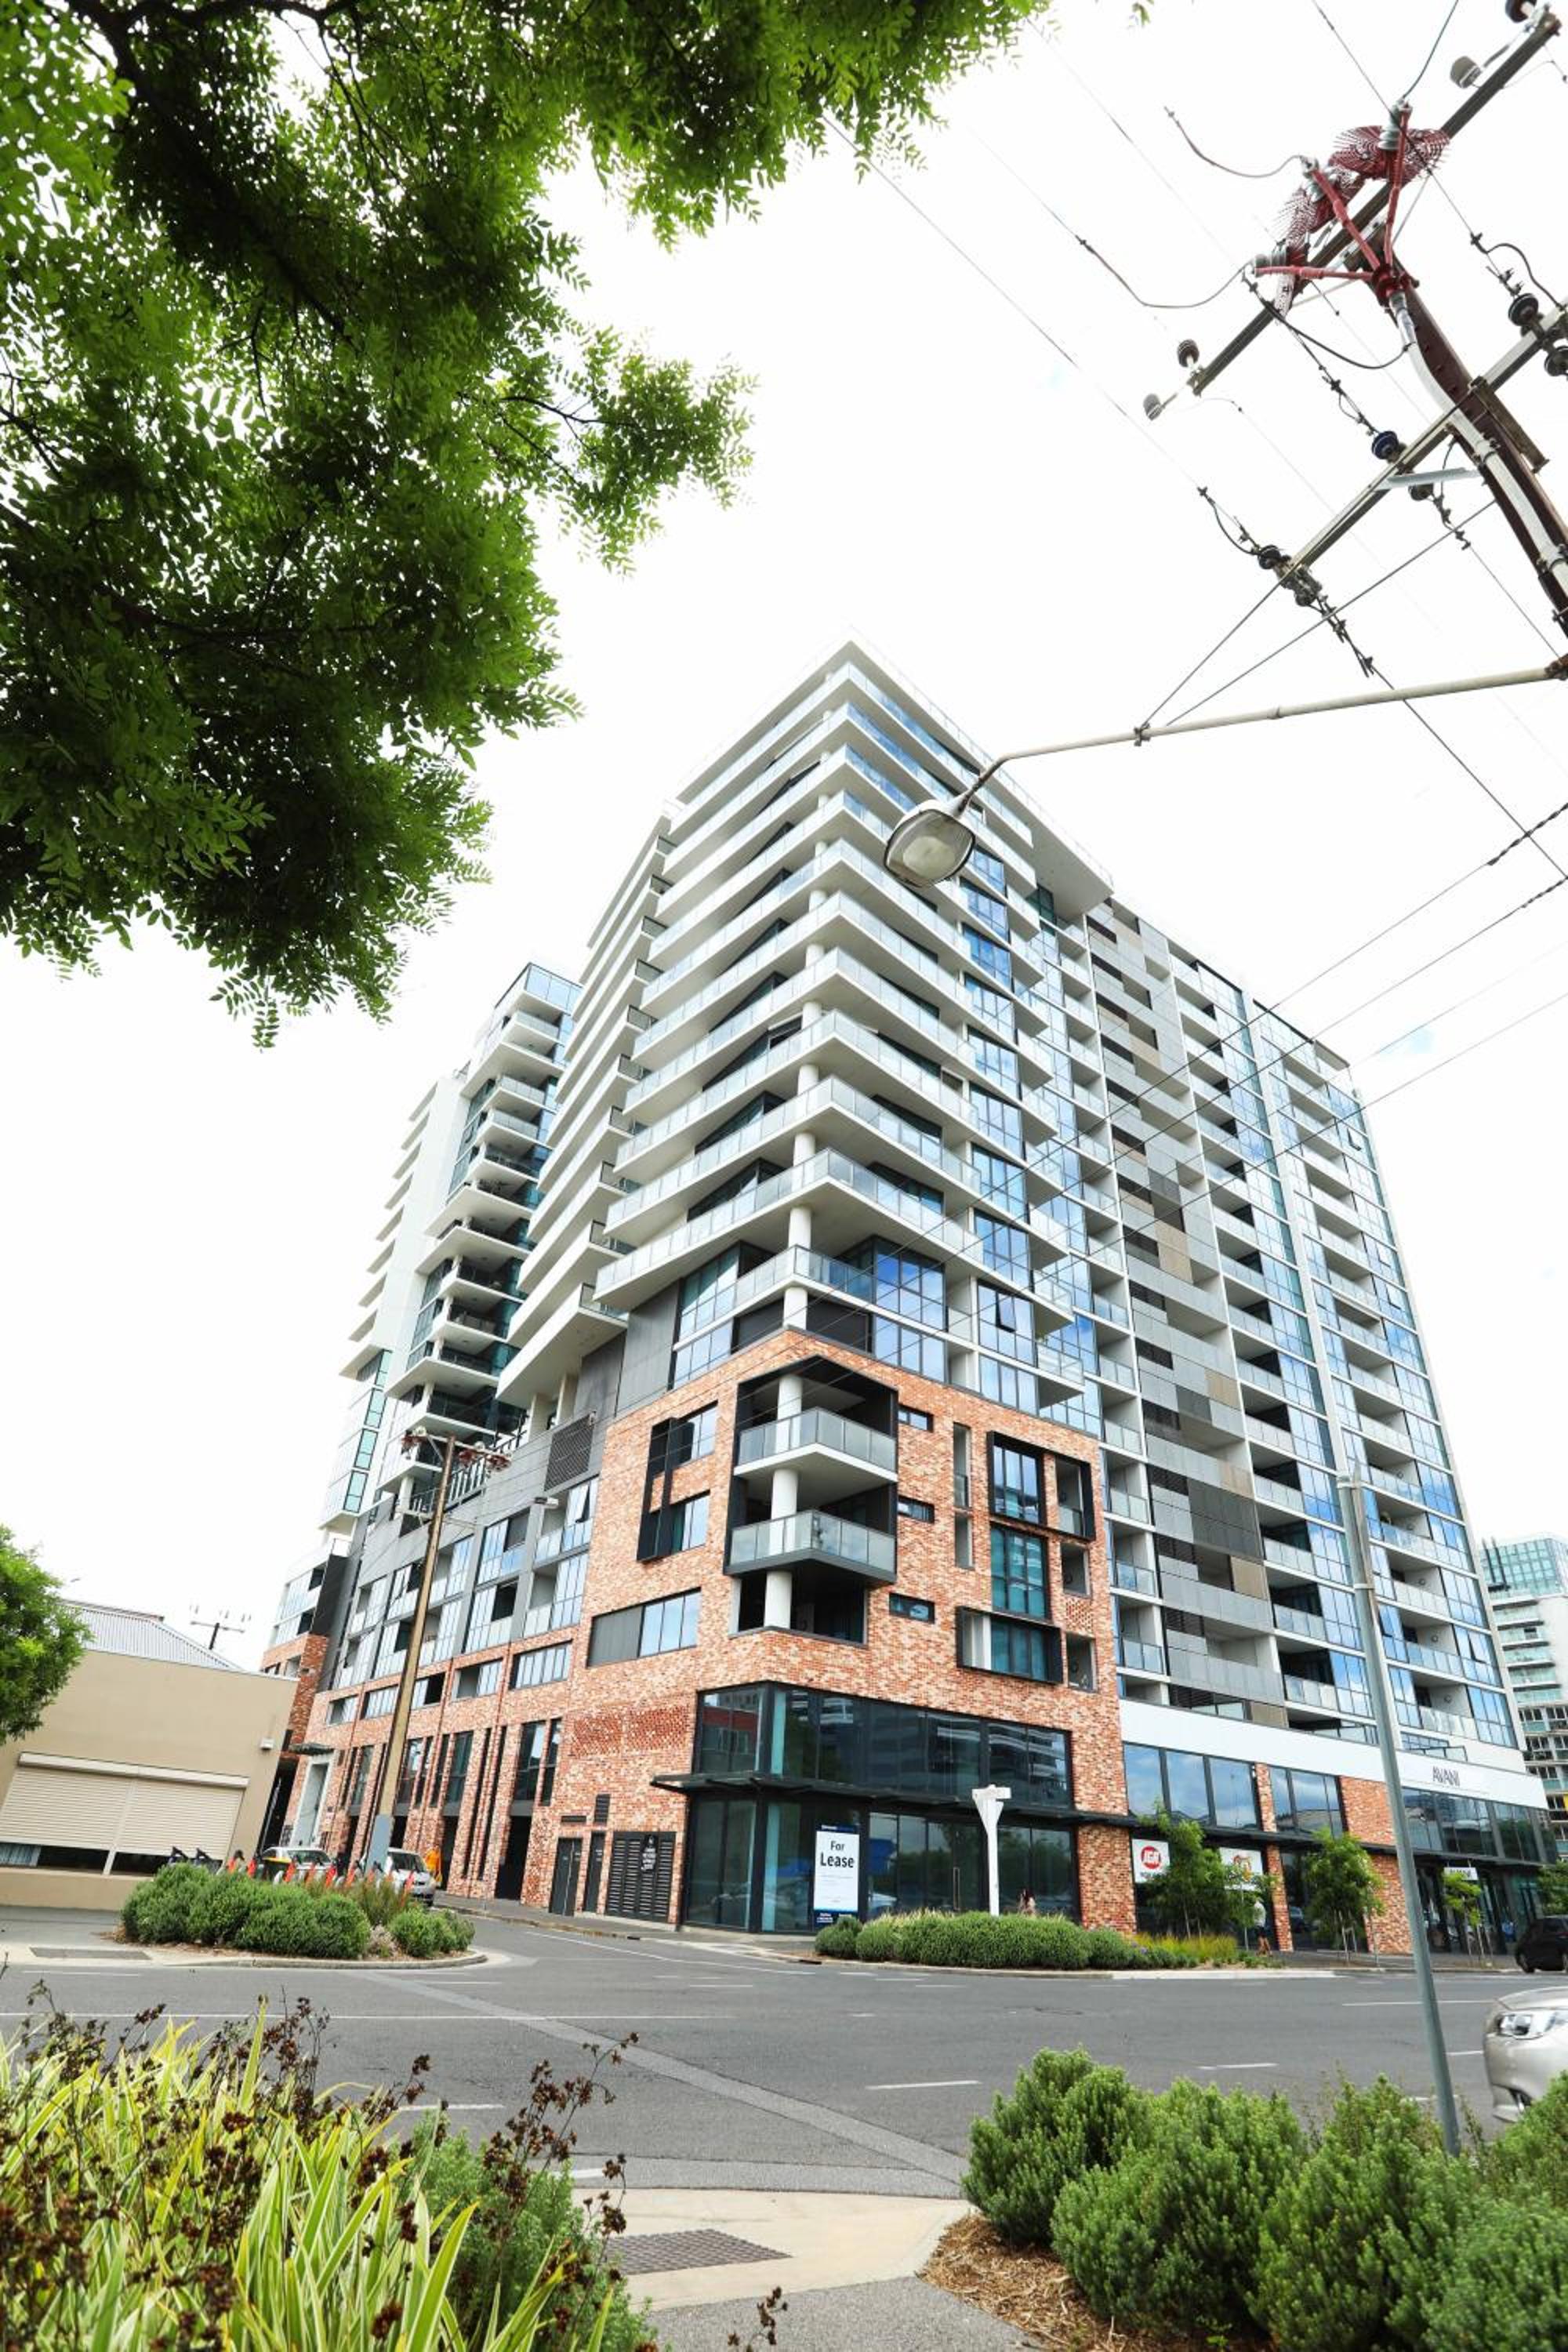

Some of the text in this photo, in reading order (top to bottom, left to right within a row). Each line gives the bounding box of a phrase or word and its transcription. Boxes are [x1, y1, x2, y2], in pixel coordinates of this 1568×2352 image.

[1432, 1765, 1461, 1787] AVANI
[830, 1840, 845, 1851] For
[820, 1852, 855, 1868] Lease
[1143, 1849, 1160, 1862] IGA
